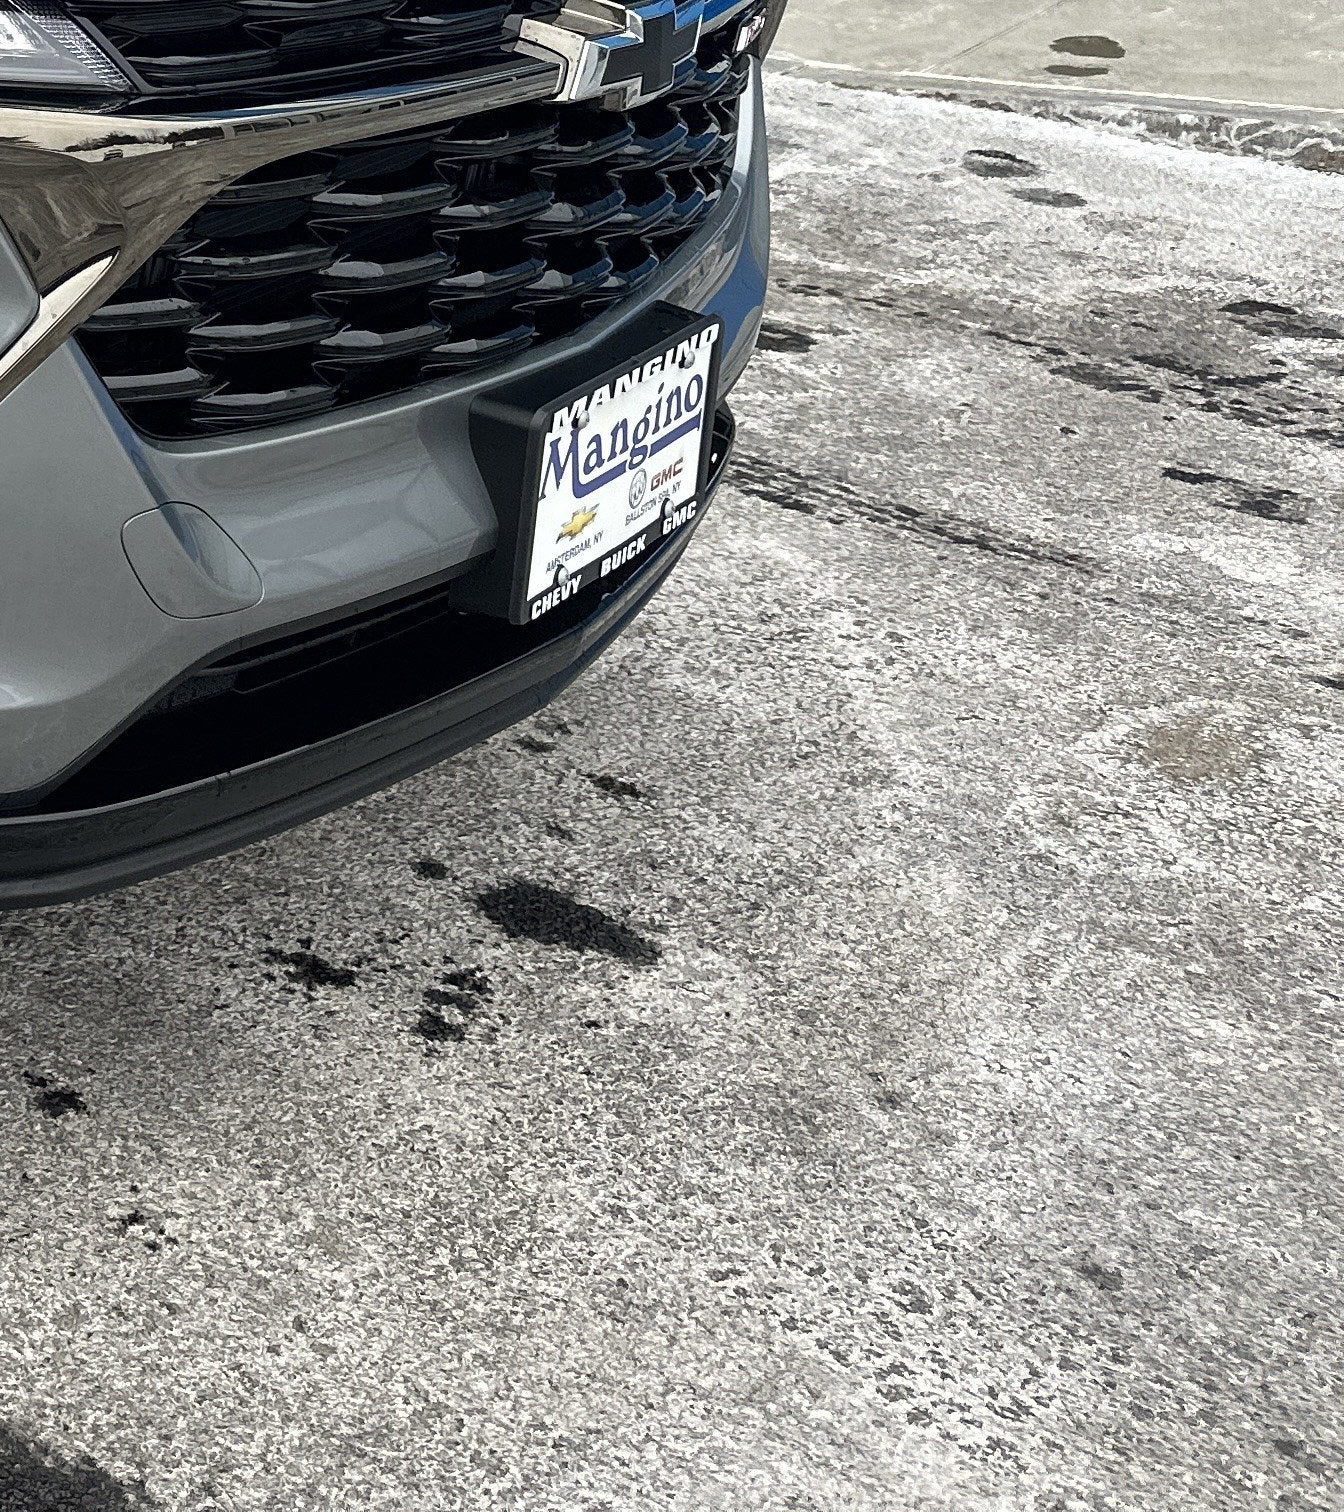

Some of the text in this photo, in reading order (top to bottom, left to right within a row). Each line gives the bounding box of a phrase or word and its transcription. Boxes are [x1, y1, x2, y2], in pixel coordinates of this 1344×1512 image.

[539, 374, 703, 499] Mangino
[551, 323, 720, 435] MANGINO
[650, 456, 684, 491] GMC
[531, 500, 697, 620] CHEVY BUICK GMC
